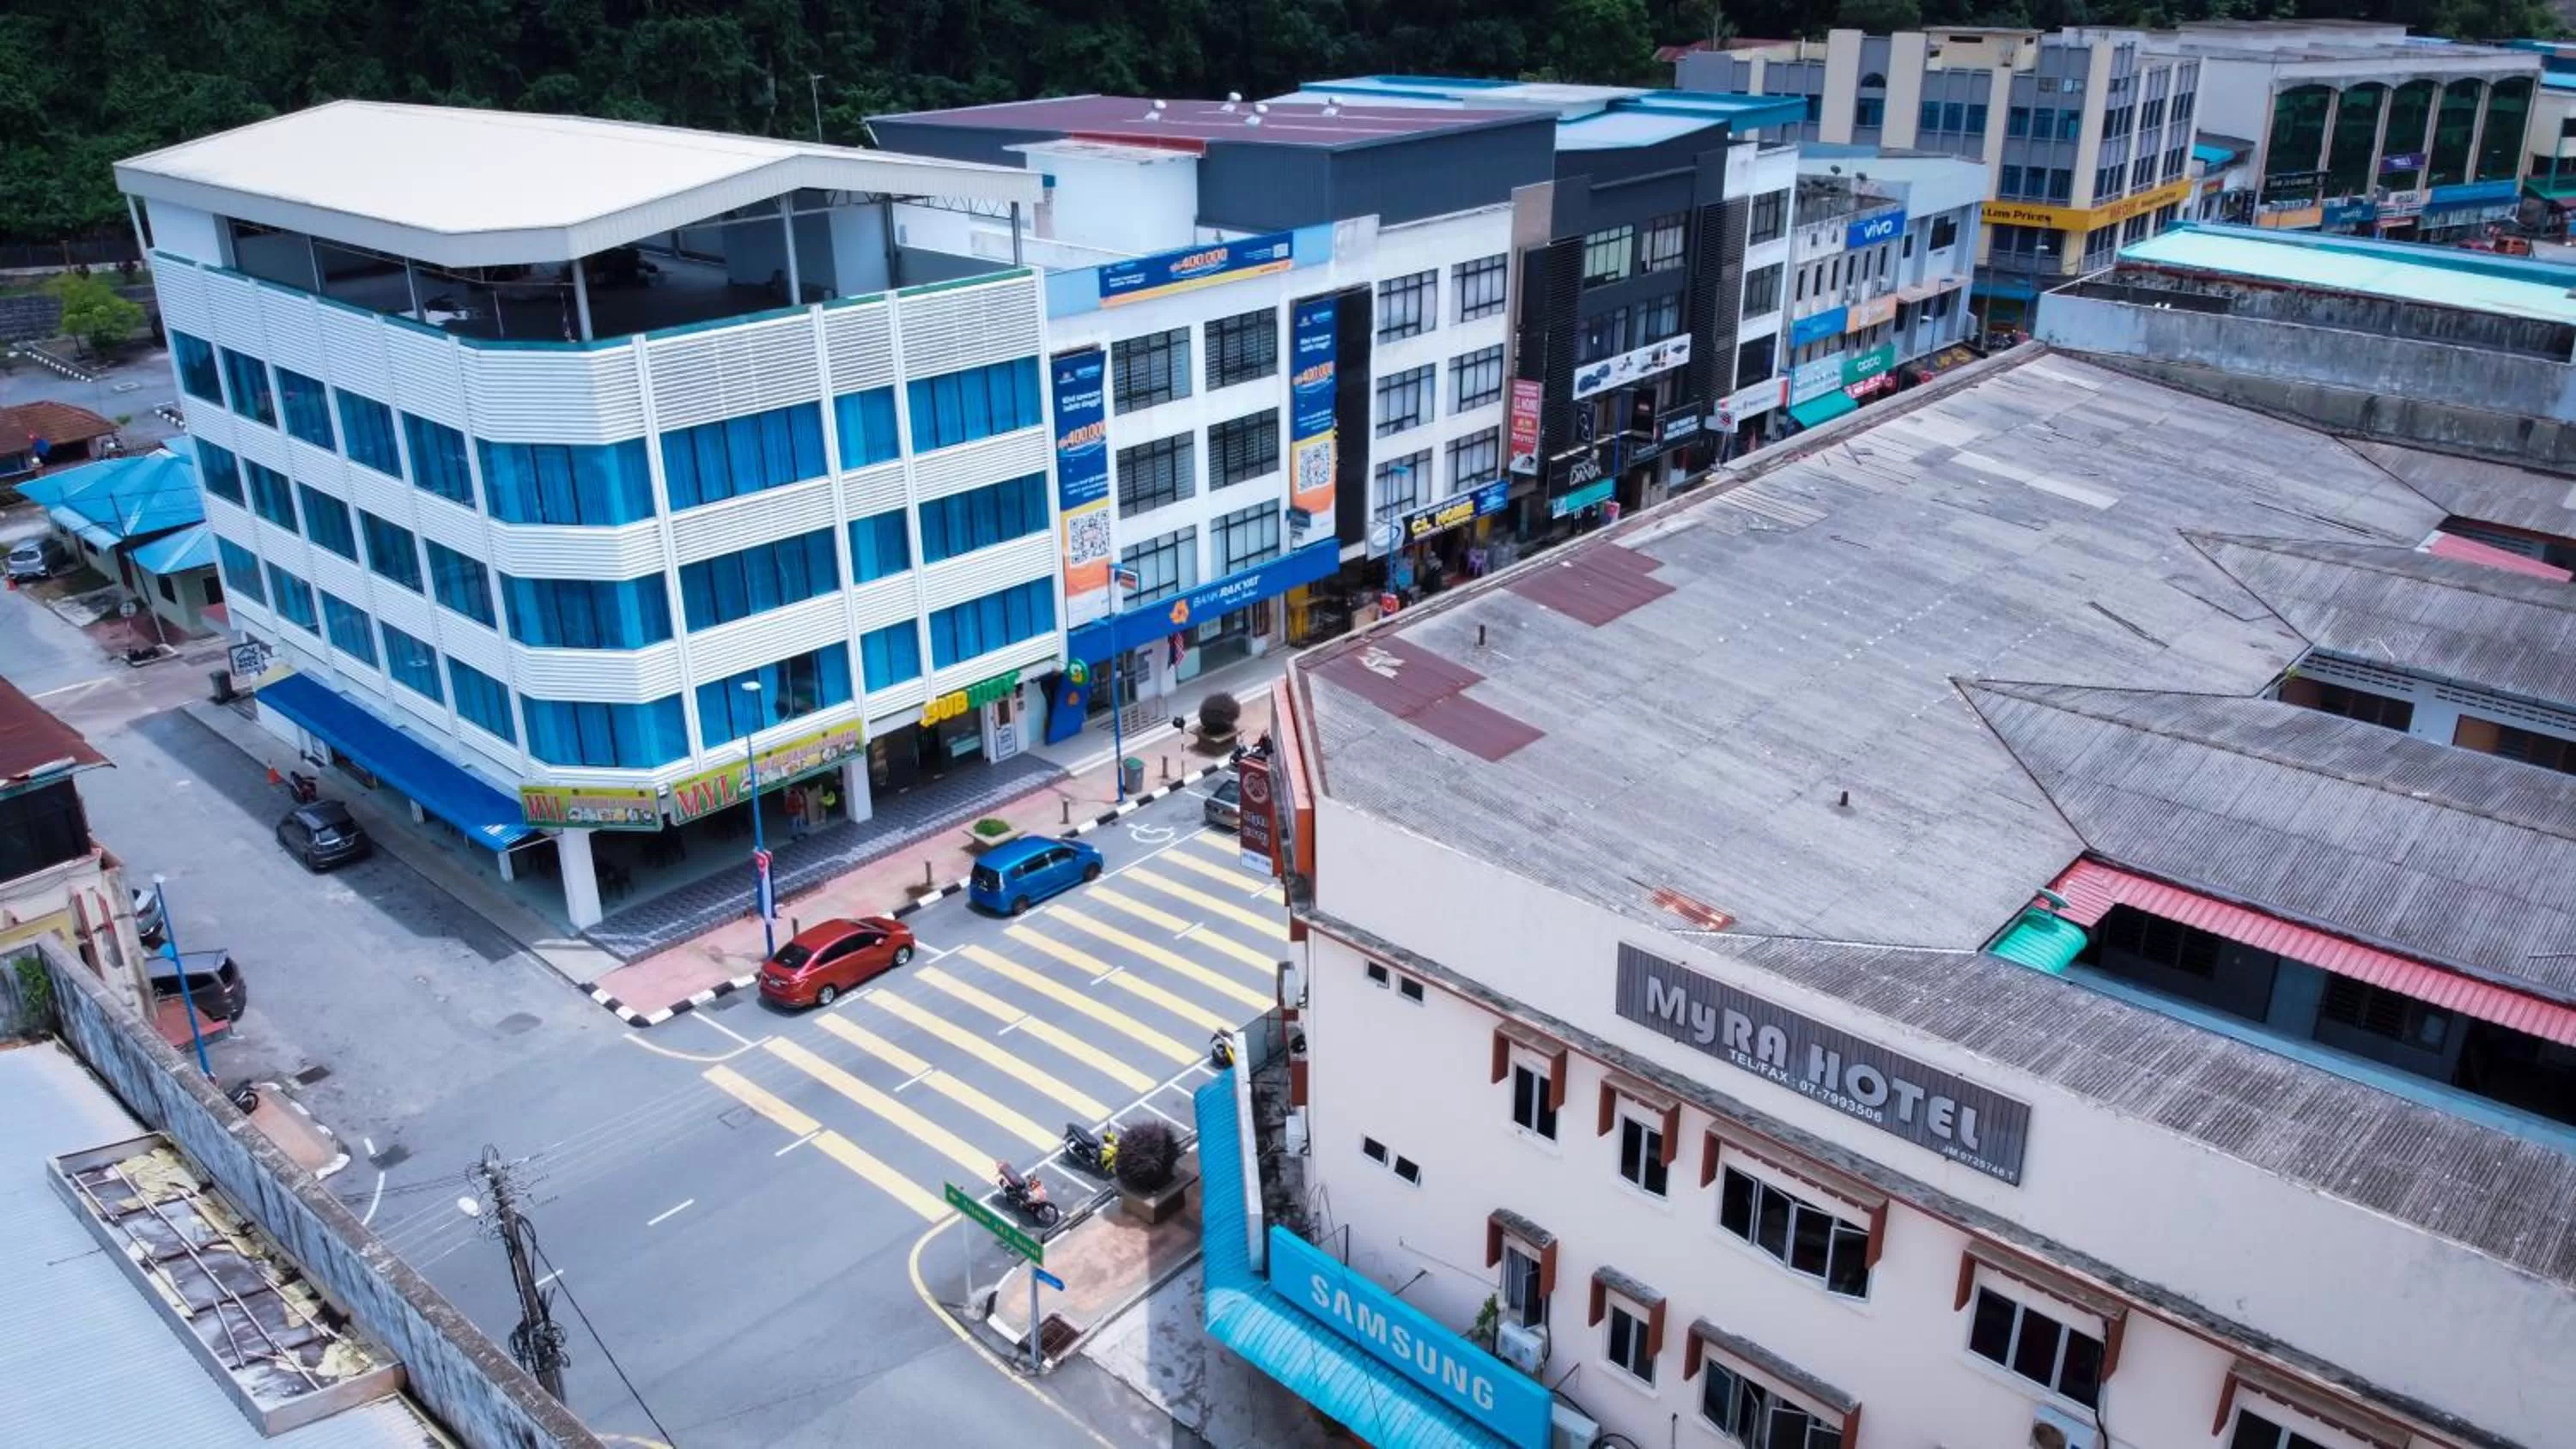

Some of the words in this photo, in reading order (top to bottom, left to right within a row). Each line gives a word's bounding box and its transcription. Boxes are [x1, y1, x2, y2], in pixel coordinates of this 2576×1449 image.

[1864, 220, 1893, 239] vivo
[1219, 574, 1261, 597] RAKYAT
[1728, 1047, 1789, 1083] TEL/FAX
[1808, 1043, 1978, 1151] HOTEL
[1310, 1274, 1494, 1410] SAMSUNG
